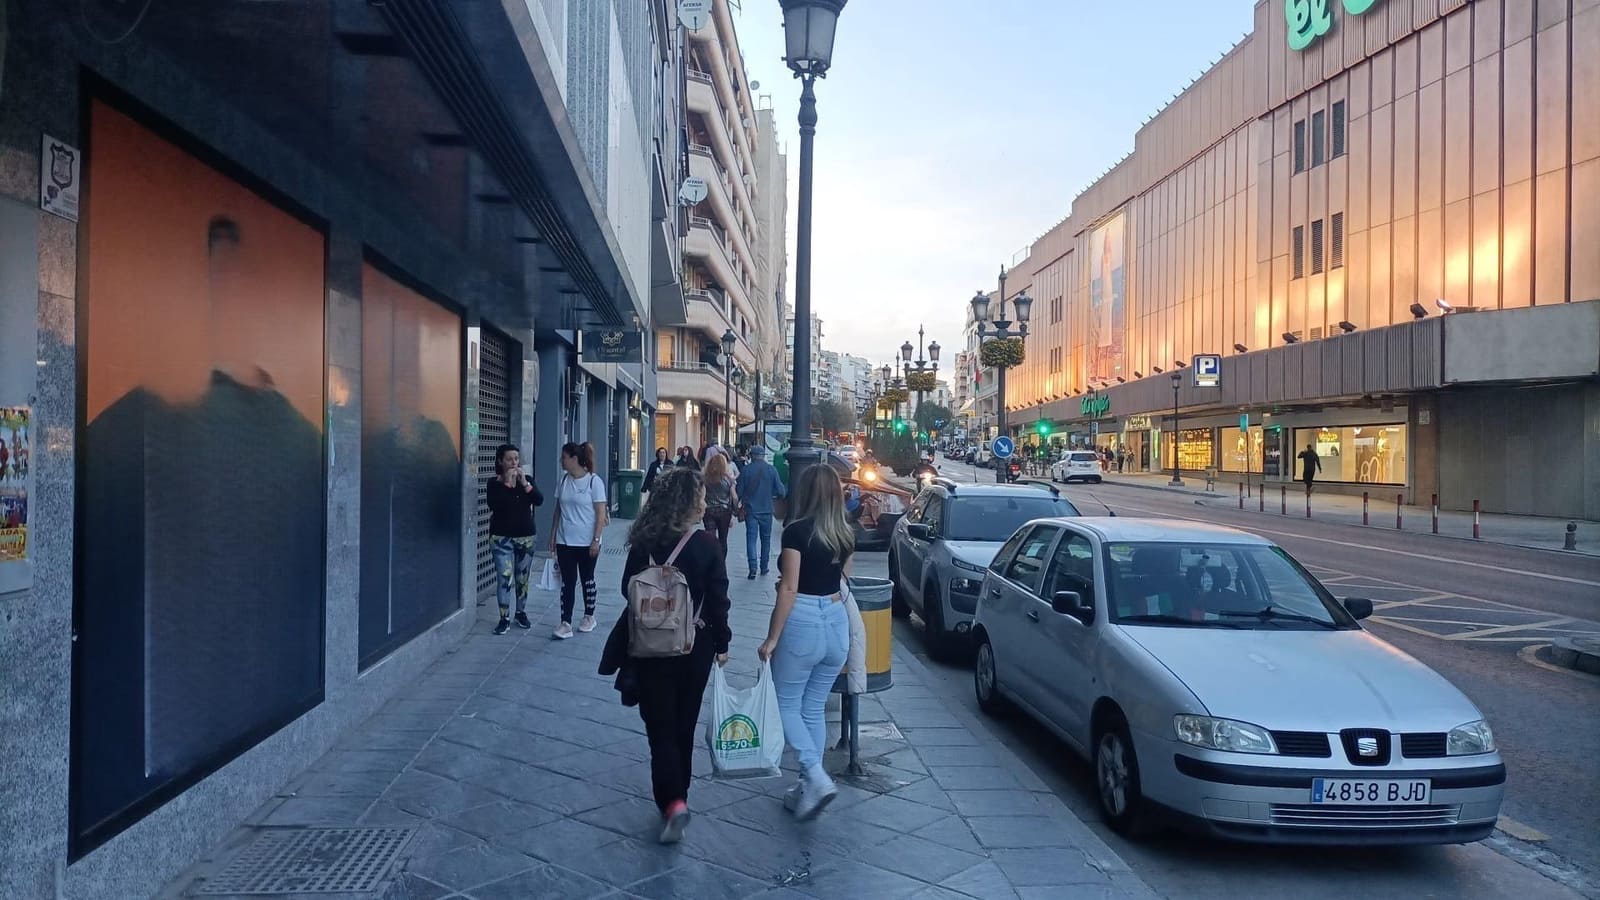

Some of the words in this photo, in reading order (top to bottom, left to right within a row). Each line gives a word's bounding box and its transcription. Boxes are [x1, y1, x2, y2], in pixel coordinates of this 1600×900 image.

[1199, 358, 1215, 374] P
[1325, 782, 1379, 802] 4858
[1387, 782, 1426, 802] BJD
